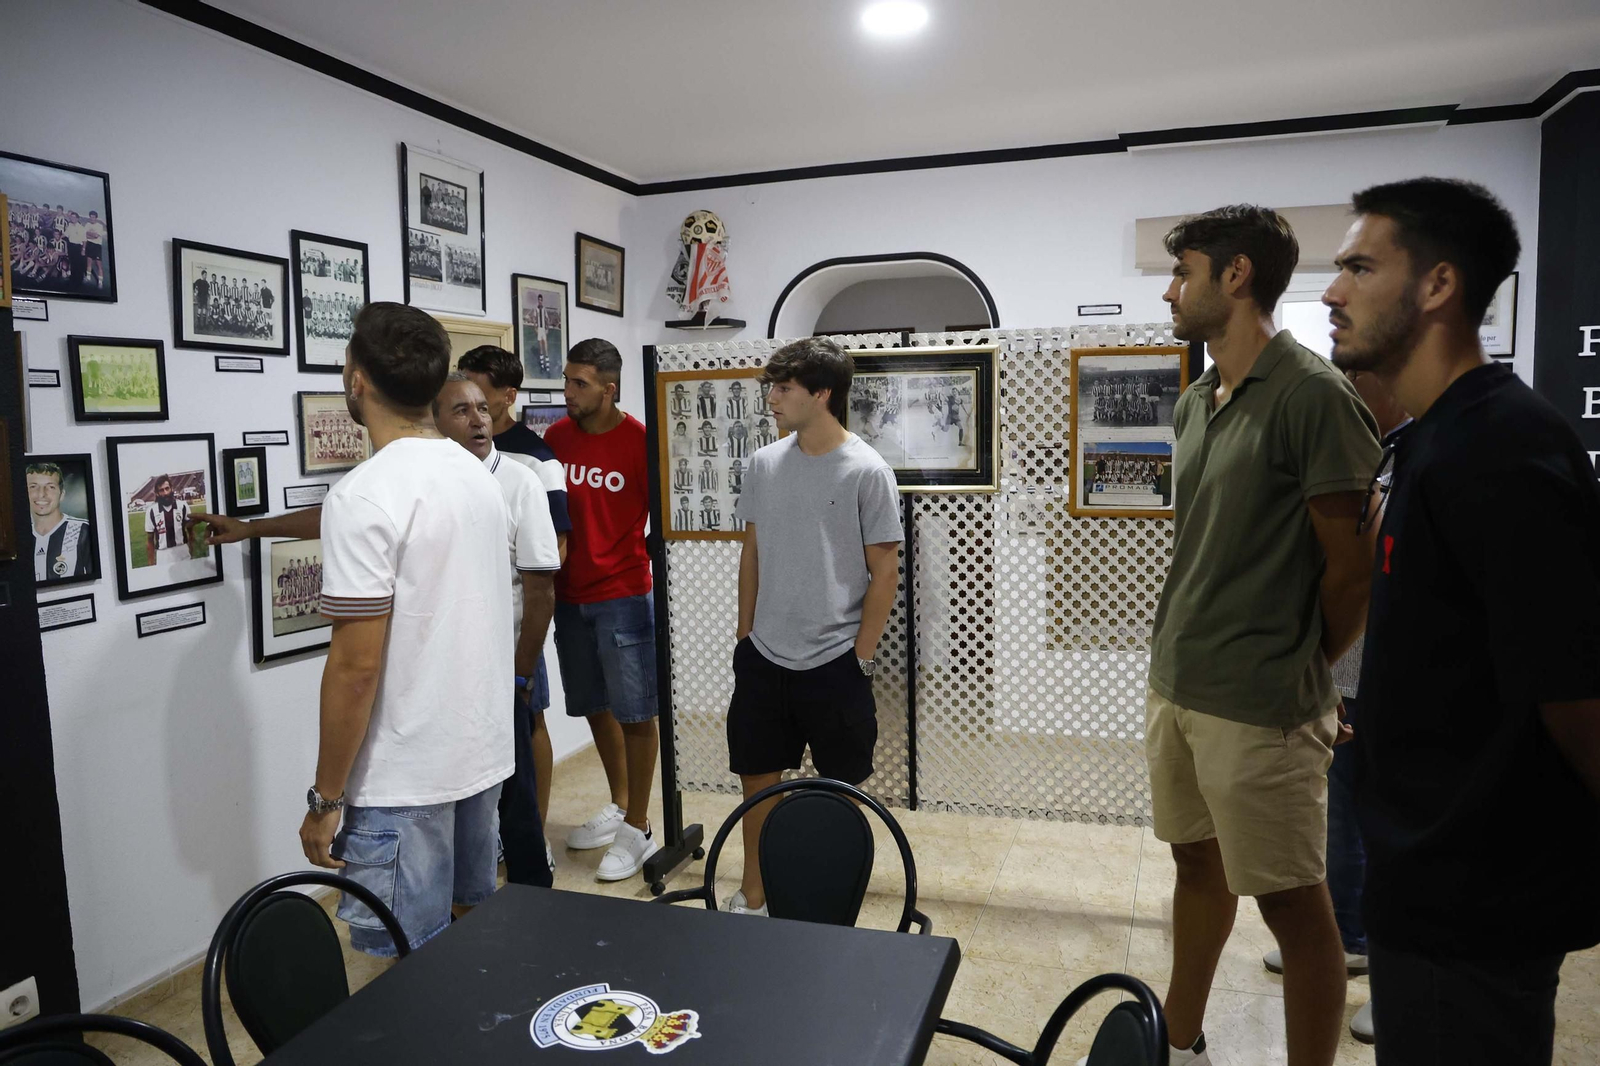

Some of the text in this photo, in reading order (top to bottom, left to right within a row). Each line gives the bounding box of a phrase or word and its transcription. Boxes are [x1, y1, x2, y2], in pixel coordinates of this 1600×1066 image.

[563, 463, 625, 492] UGO
[547, 988, 598, 1012] FUNDADA
[572, 998, 587, 1006] LA
[540, 1013, 551, 1023] EN
[600, 1025, 647, 1046] BALONA
